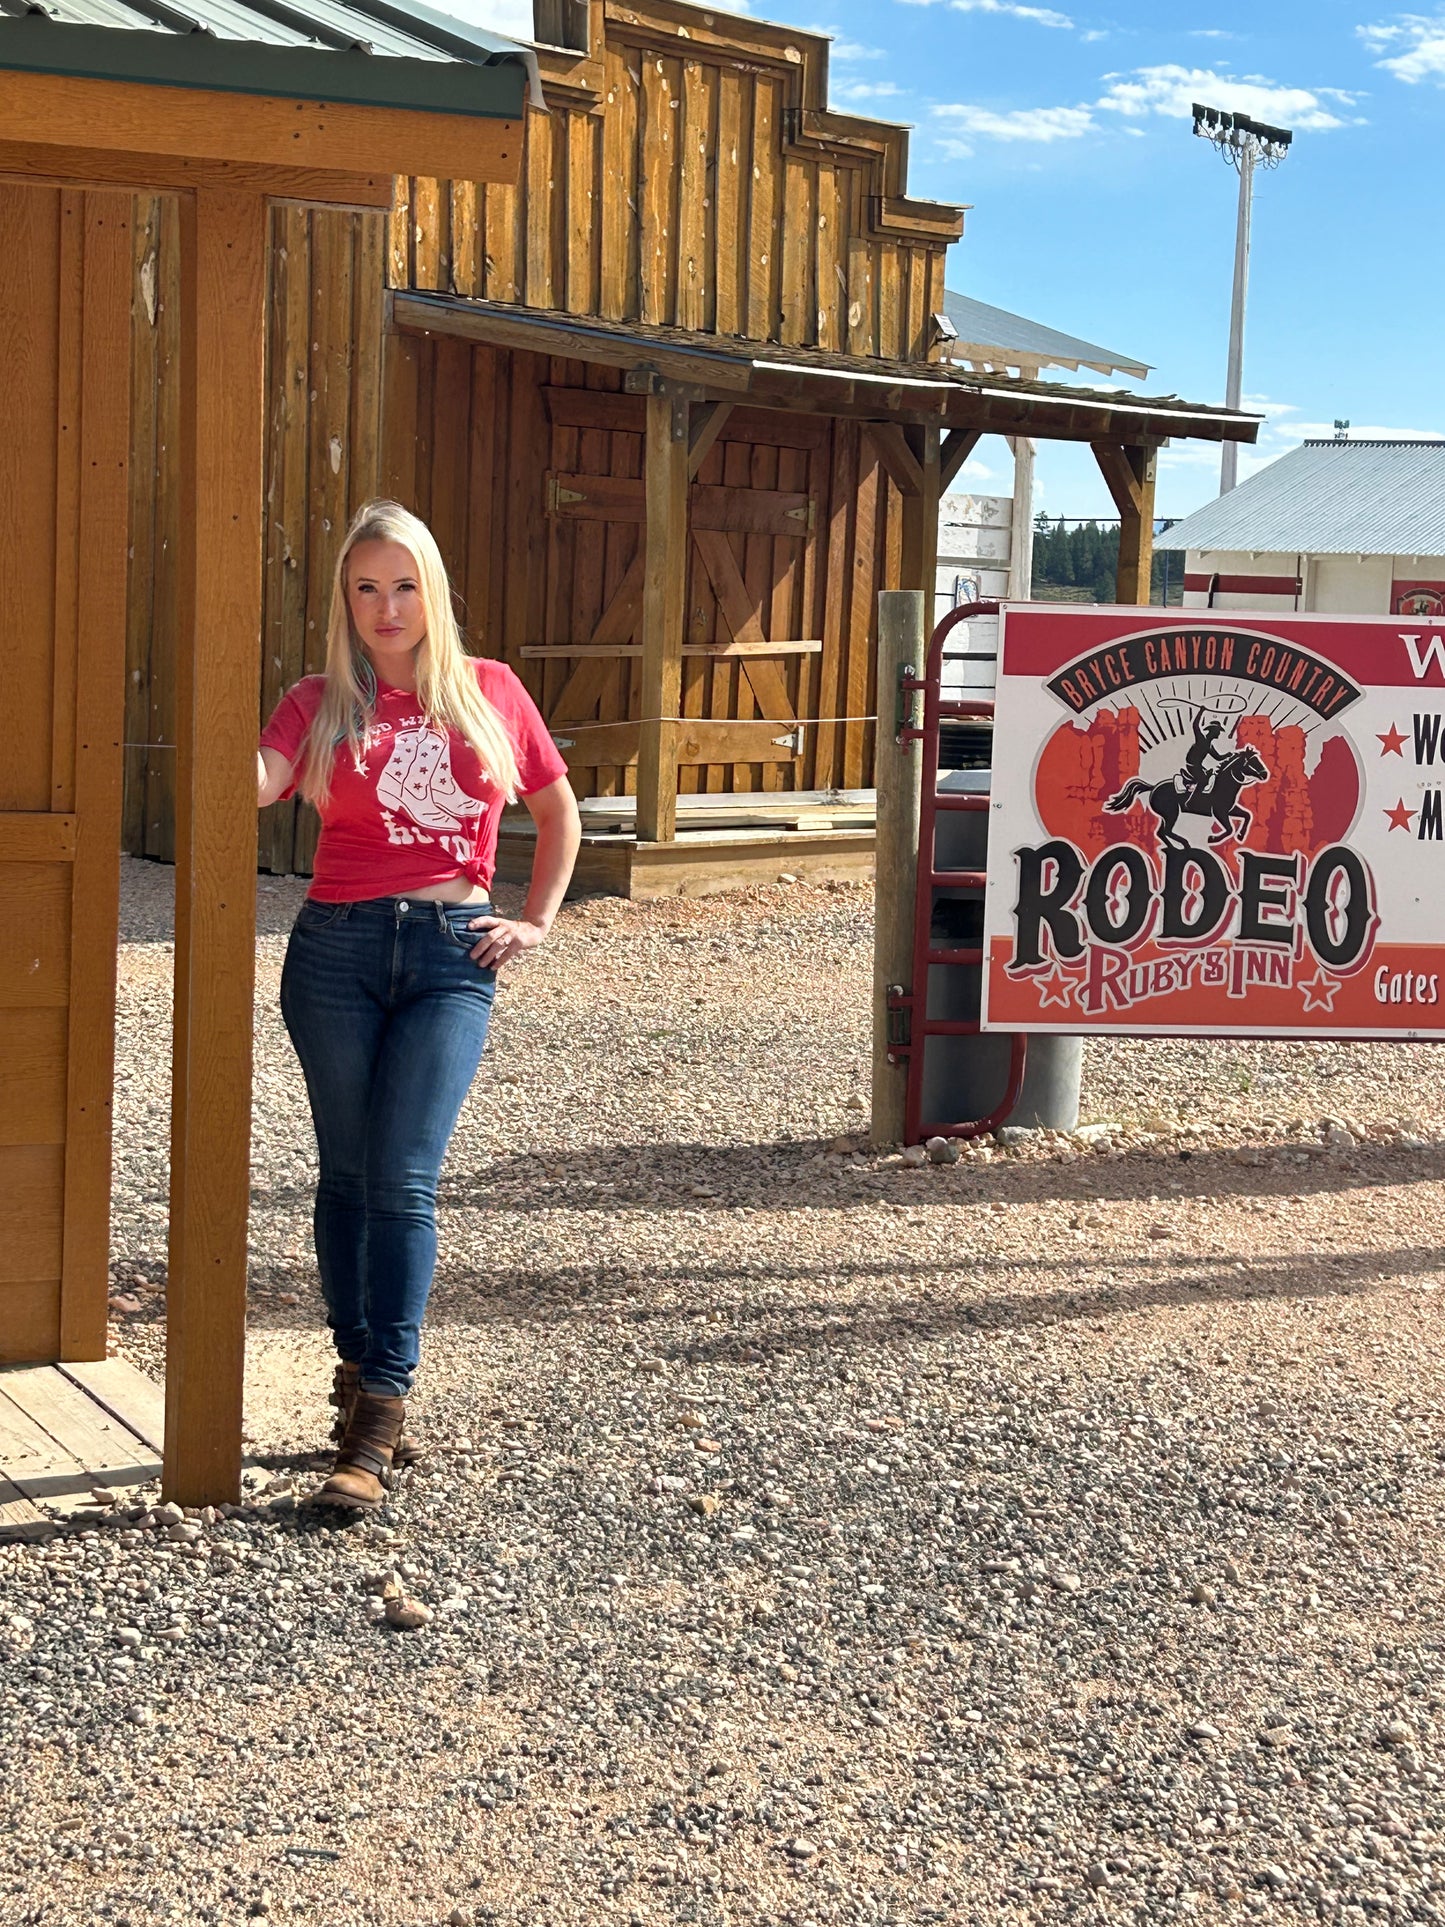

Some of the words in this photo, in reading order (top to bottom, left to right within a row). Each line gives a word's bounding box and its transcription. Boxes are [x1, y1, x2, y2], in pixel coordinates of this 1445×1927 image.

[1061, 648, 1136, 707] BRYCE
[1144, 636, 1235, 674] CANYON
[1246, 642, 1349, 713] COUNTRY
[1007, 841, 1377, 971] RODEO
[1230, 950, 1292, 995] INN
[1374, 964, 1439, 1004] Gates
